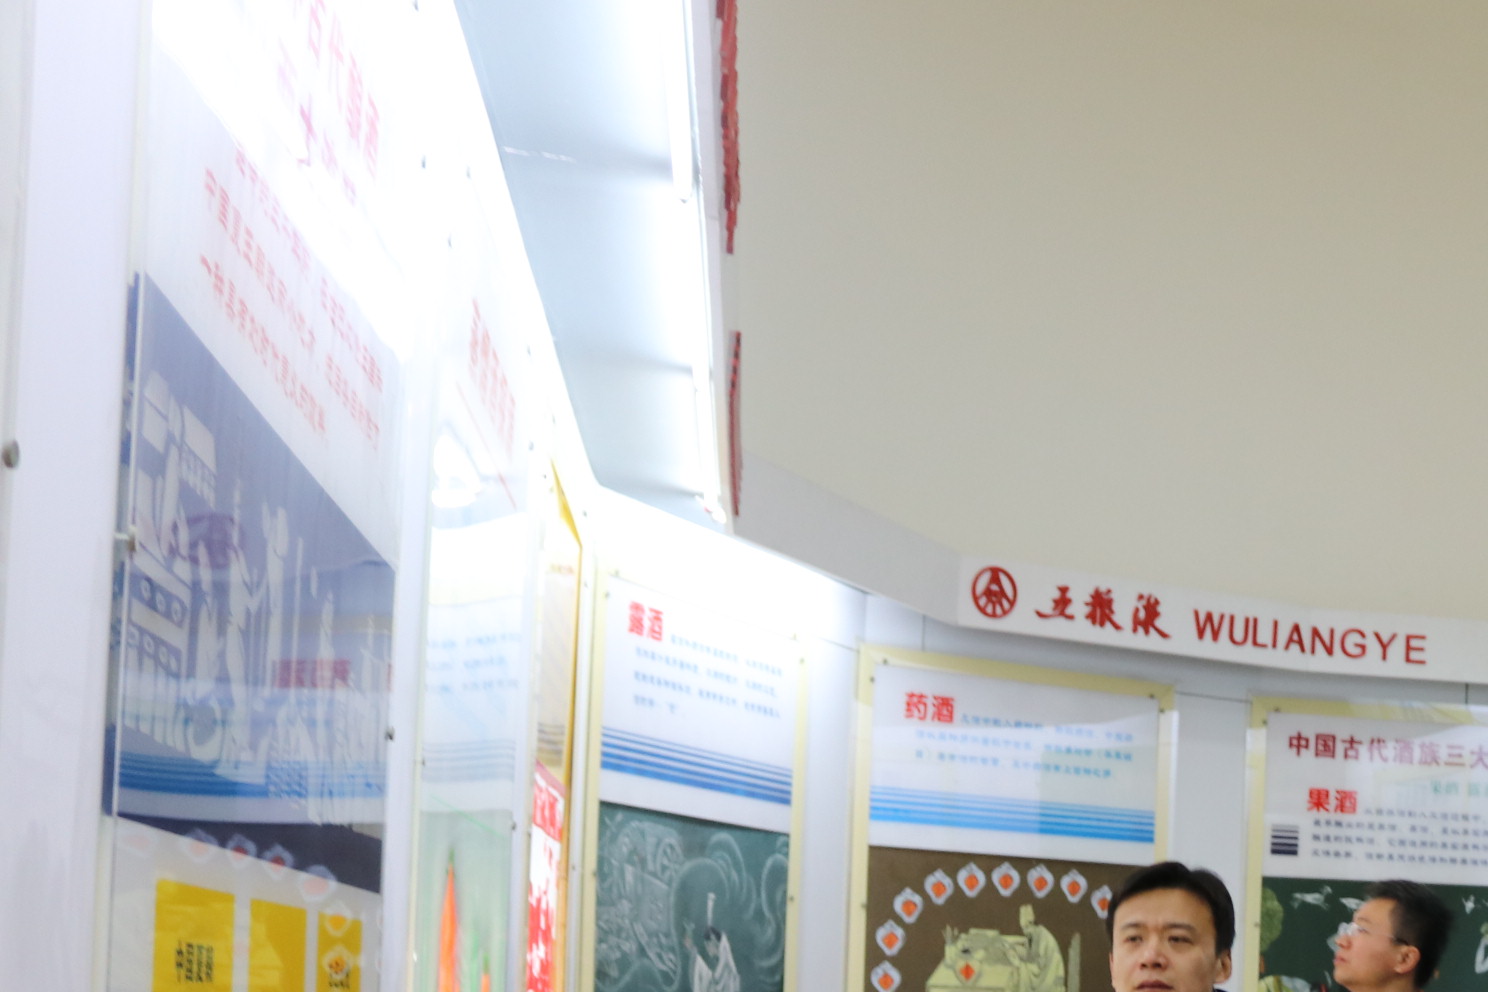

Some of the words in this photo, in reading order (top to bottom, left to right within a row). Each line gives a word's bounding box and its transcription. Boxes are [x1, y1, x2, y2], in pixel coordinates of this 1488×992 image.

[1194, 609, 1428, 664] WULIANGYE
[904, 691, 955, 724] 药酒
[1307, 787, 1358, 815] 果酒
